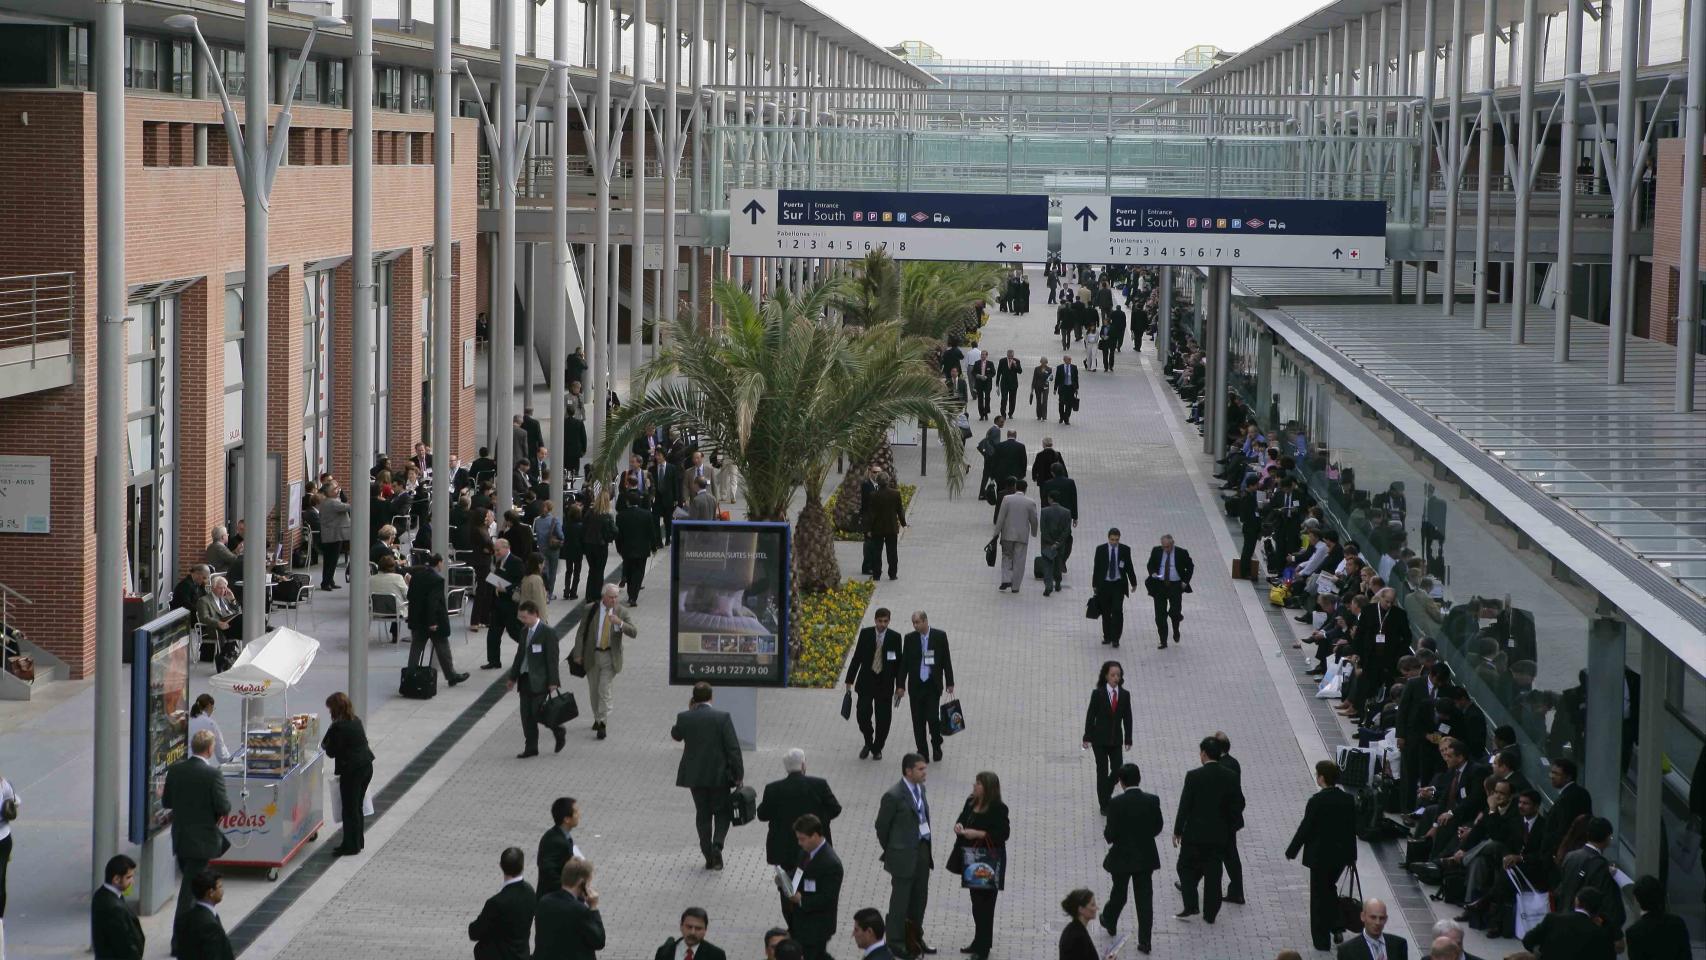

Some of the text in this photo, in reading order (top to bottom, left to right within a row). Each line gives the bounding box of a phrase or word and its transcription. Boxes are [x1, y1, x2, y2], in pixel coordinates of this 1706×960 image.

[783, 210, 803, 220] Sur
[814, 210, 846, 221] South
[1116, 216, 1136, 227] Sur
[1147, 216, 1179, 228] South
[777, 240, 906, 251] 1 2 3 4 5 6 7 8
[1109, 247, 1240, 258] 1 2 3 4 5 6 7 8
[700, 665, 715, 674] +34
[758, 667, 768, 675] 00
